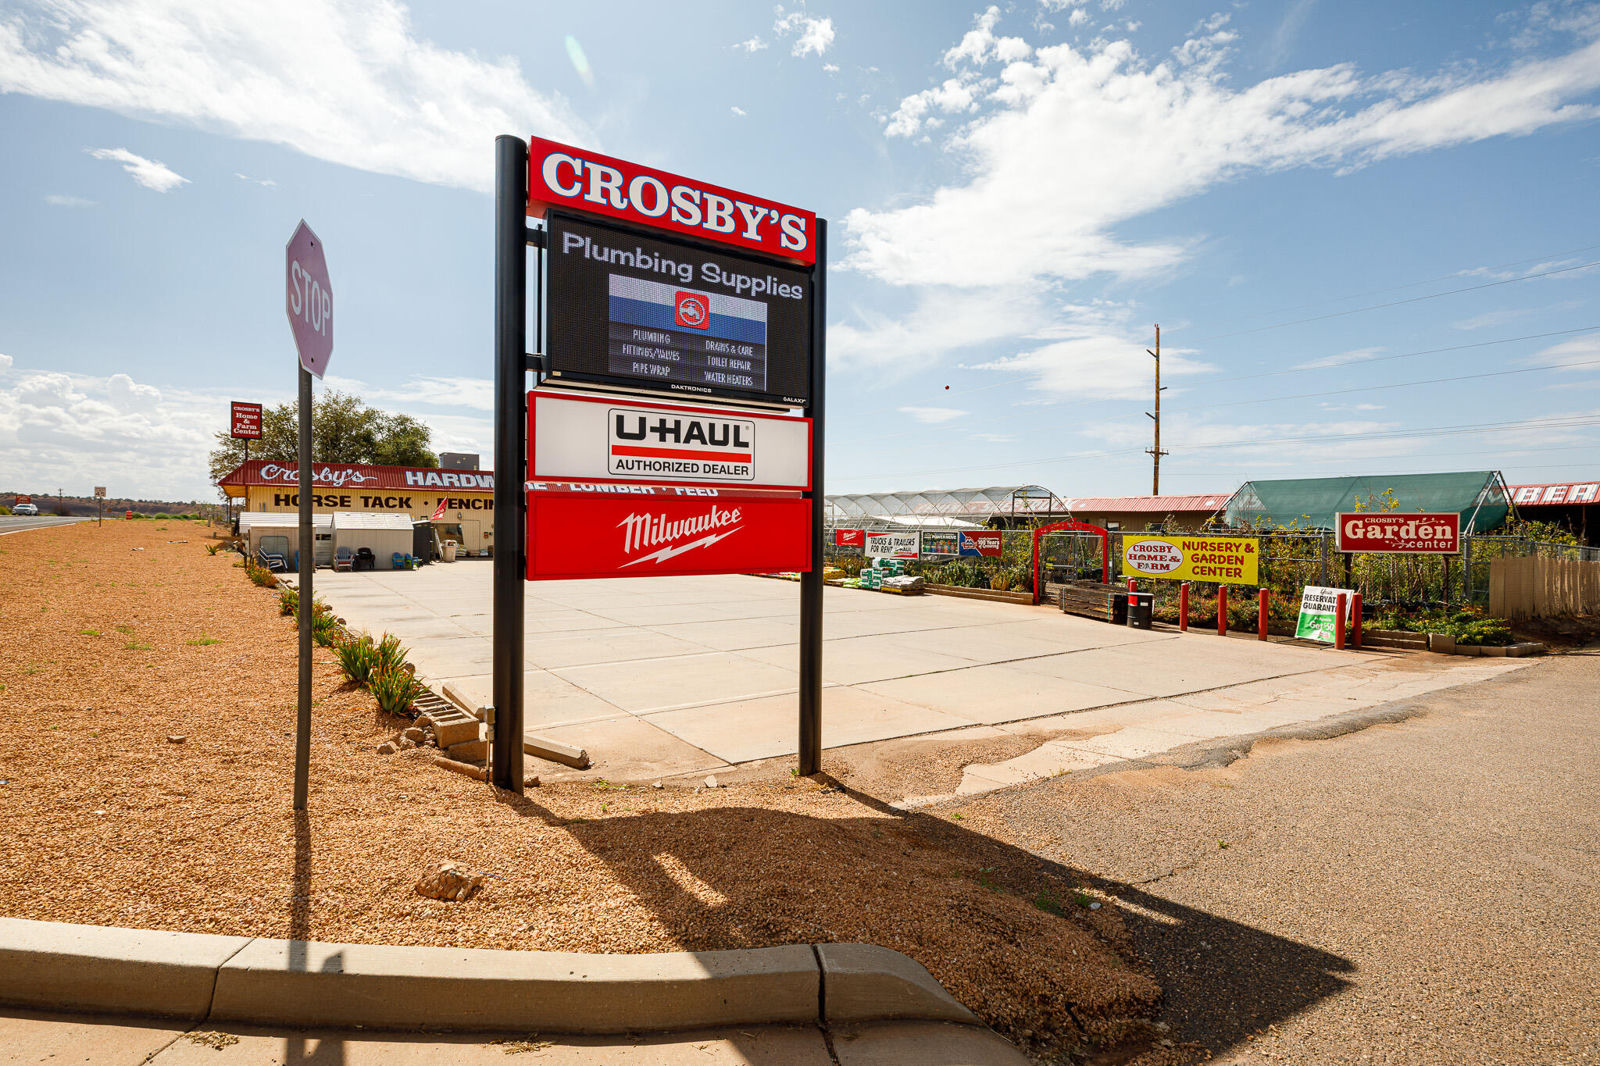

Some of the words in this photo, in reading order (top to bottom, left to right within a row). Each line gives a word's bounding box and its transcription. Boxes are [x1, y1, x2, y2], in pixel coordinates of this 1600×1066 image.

[542, 152, 807, 252] CROSBY'S
[562, 231, 693, 282] Plumbing
[701, 262, 803, 300] Supplies
[290, 260, 330, 337] STOP
[633, 329, 671, 344] PLUMBING
[705, 340, 729, 352] DRAINS
[731, 344, 736, 353] &
[738, 345, 753, 356] CARE
[632, 362, 648, 374] PIPE
[650, 364, 670, 376] WRAP
[707, 355, 727, 367] TOILET
[729, 358, 751, 371] REPAIR
[704, 371, 725, 383] WATER
[727, 374, 753, 386] HEATERS
[671, 384, 712, 393] DAKTRONICS
[615, 459, 700, 474] AUTHORIZED
[703, 463, 749, 476] DEALER
[360, 496, 412, 508] TACK
[616, 505, 741, 554] Milwaukee
[1345, 520, 1453, 539] Garden
[894, 538, 915, 546] TRAILERS
[1133, 544, 1173, 553] CROSBY
[1182, 541, 1242, 552] NURSERY
[1245, 543, 1255, 553] &
[1409, 540, 1453, 548] center
[1191, 554, 1244, 565] GARDEN
[1192, 566, 1242, 578] CENTER
